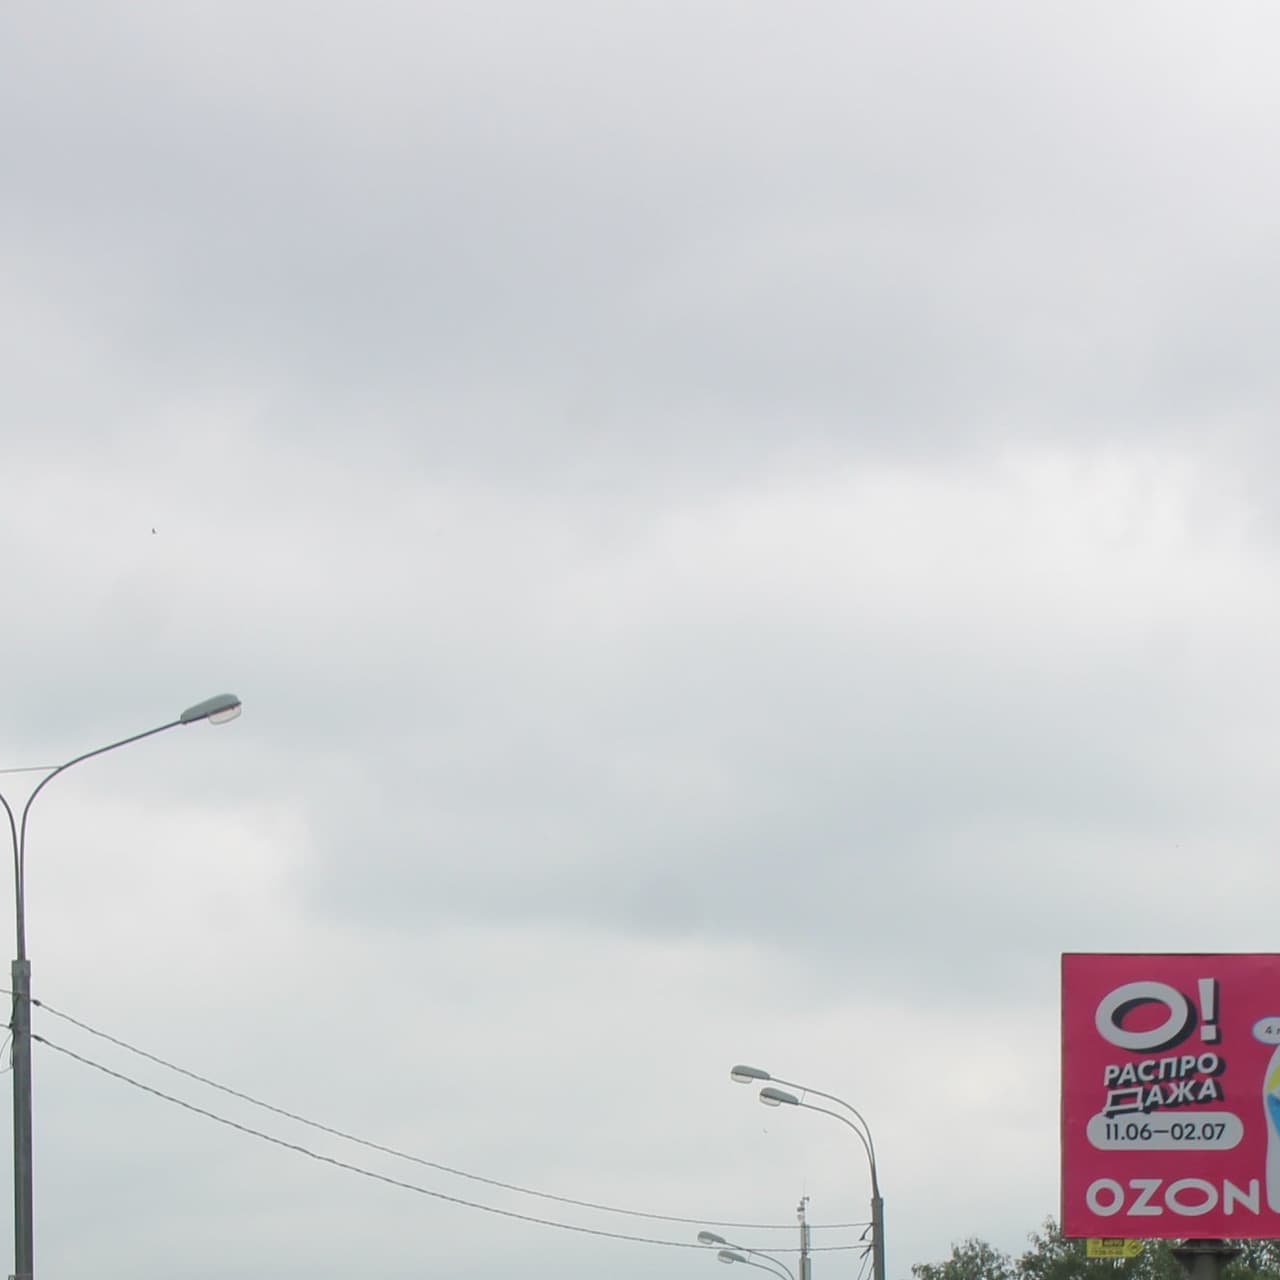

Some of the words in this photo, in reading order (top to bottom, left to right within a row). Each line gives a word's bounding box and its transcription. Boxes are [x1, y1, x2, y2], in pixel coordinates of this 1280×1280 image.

[1095, 978, 1219, 1051] О!
[1104, 1053, 1219, 1086] РАСПРО
[1103, 1079, 1218, 1113] ДАЖА
[1086, 1178, 1260, 1217] OZON
